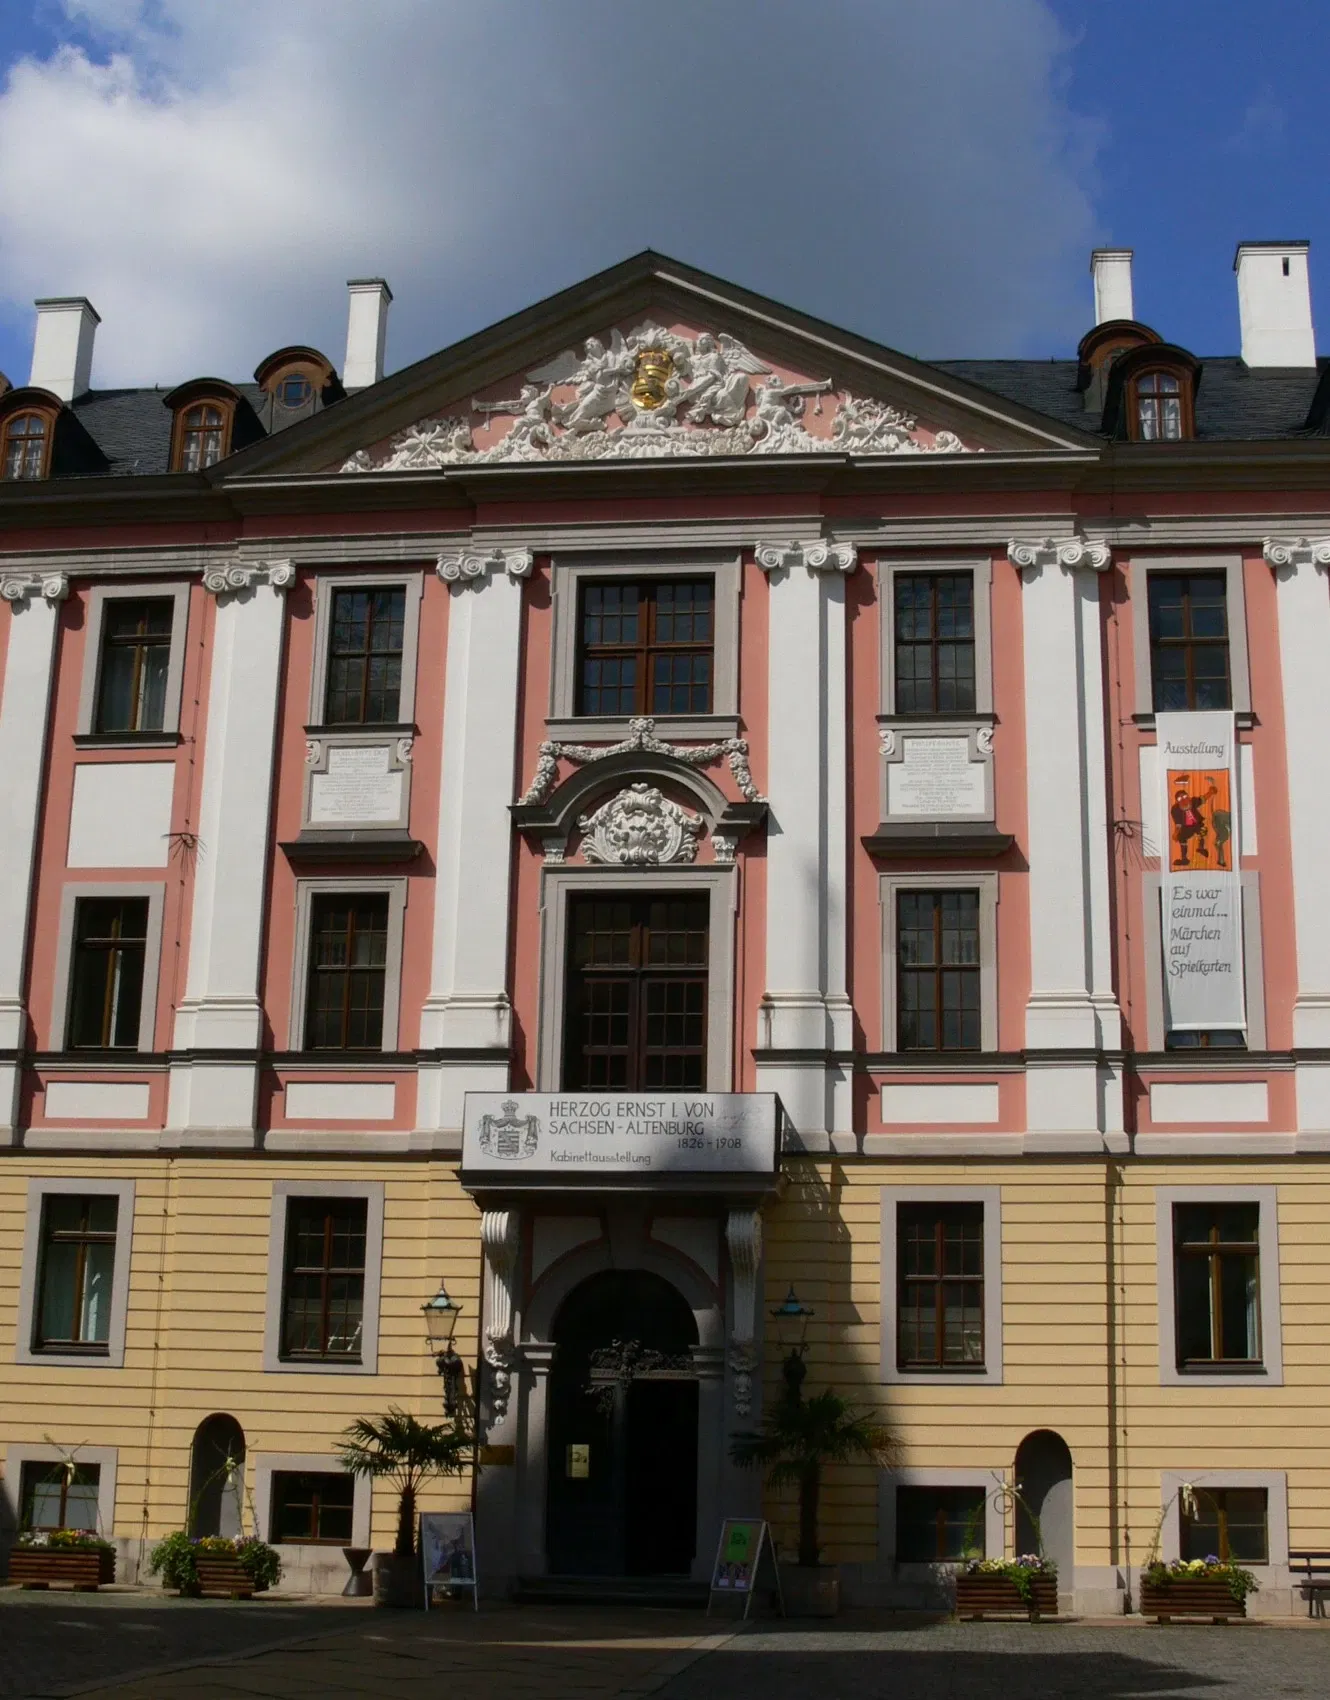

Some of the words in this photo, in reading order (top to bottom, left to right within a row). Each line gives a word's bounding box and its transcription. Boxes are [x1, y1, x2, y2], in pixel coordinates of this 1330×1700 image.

[1163, 741, 1225, 758] Ausstellung
[1172, 885, 1193, 901] Es
[1195, 888, 1222, 901] war
[1171, 902, 1229, 919] einmal...
[1170, 924, 1221, 941] Märchen
[1170, 942, 1192, 957] auf
[1168, 958, 1232, 979] Spielkarten
[549, 1101, 611, 1118] HERZOG
[616, 1101, 667, 1118] ERNST
[671, 1102, 679, 1118] I.
[684, 1102, 714, 1118] VON
[550, 1149, 651, 1166] Kabinettausstellung
